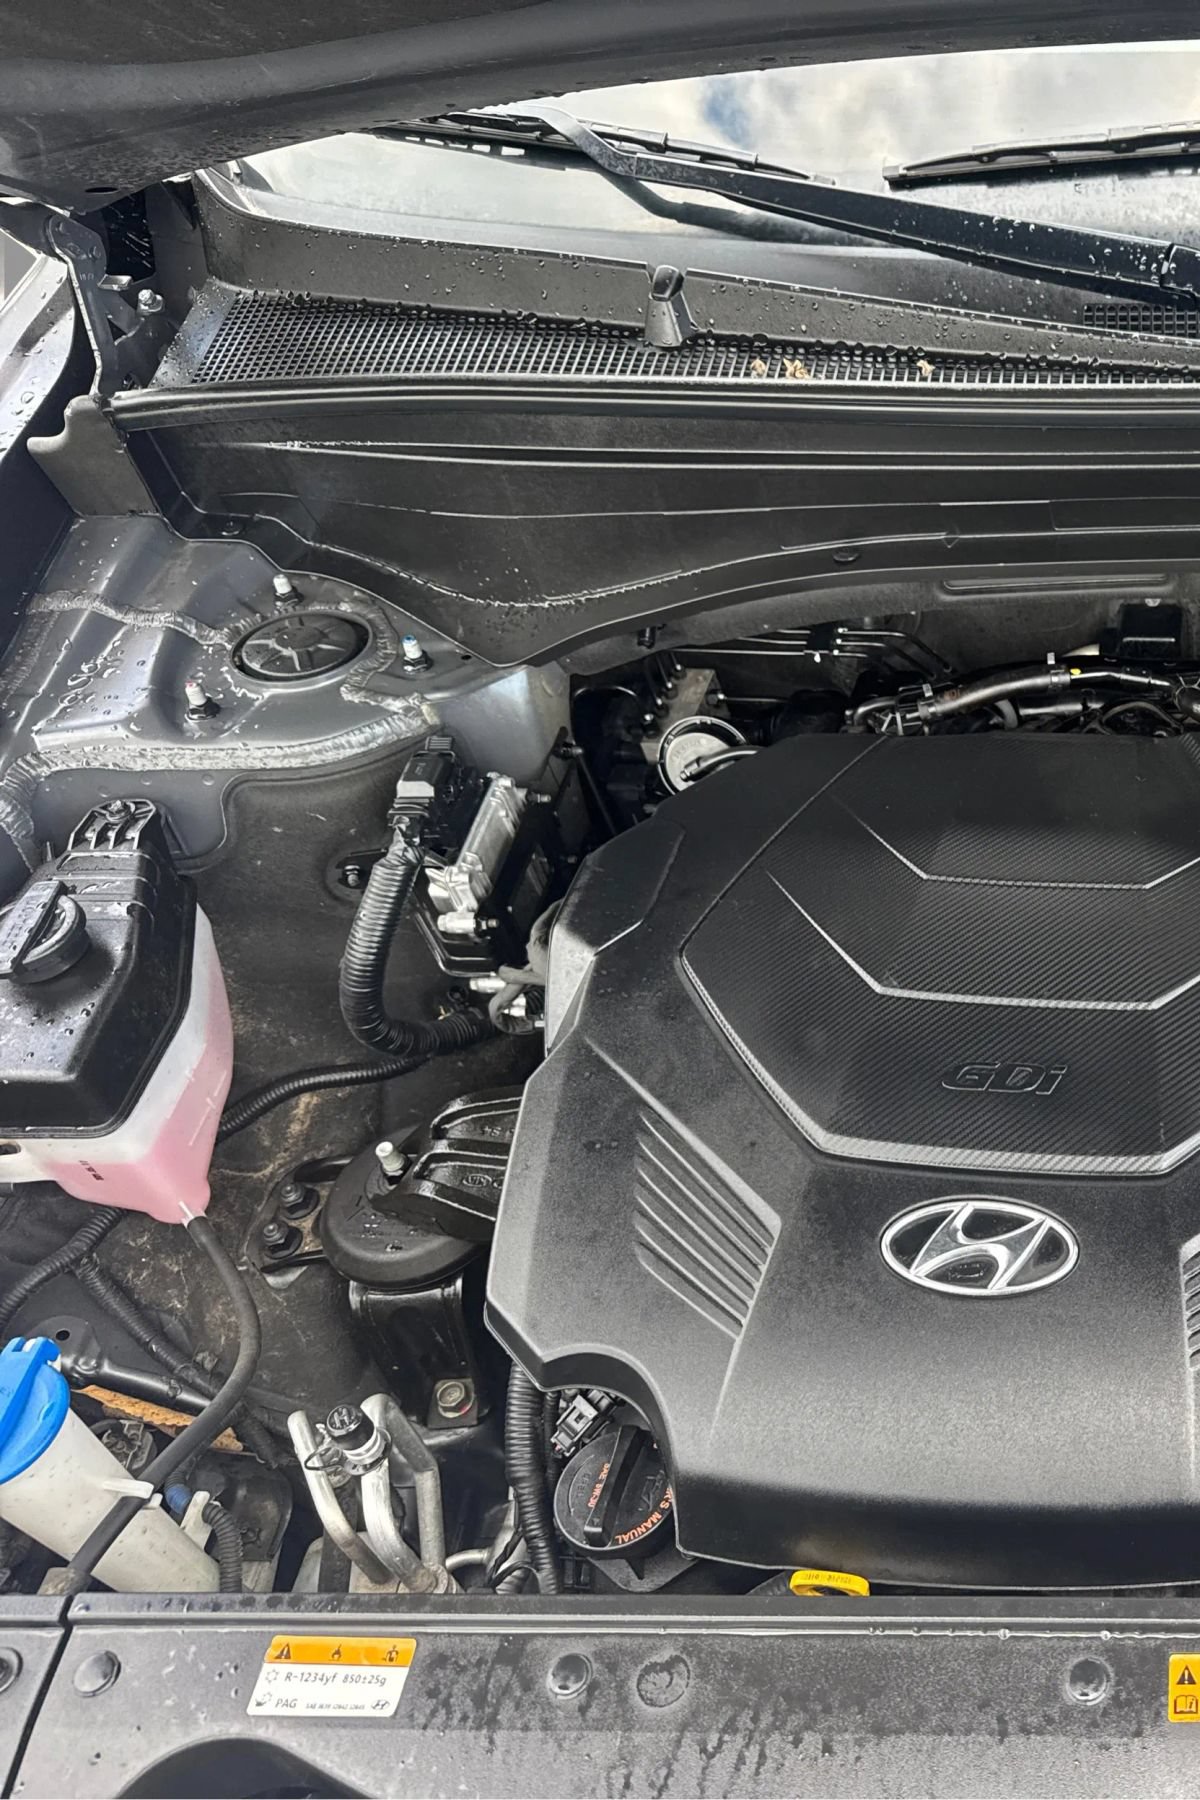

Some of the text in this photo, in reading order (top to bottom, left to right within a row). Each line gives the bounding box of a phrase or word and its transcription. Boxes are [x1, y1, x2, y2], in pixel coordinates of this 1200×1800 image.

[615, 1511, 662, 1545] MANUAL
[284, 1671, 387, 1687] R-1234yf 850±25g
[275, 1698, 298, 1709] PAG
